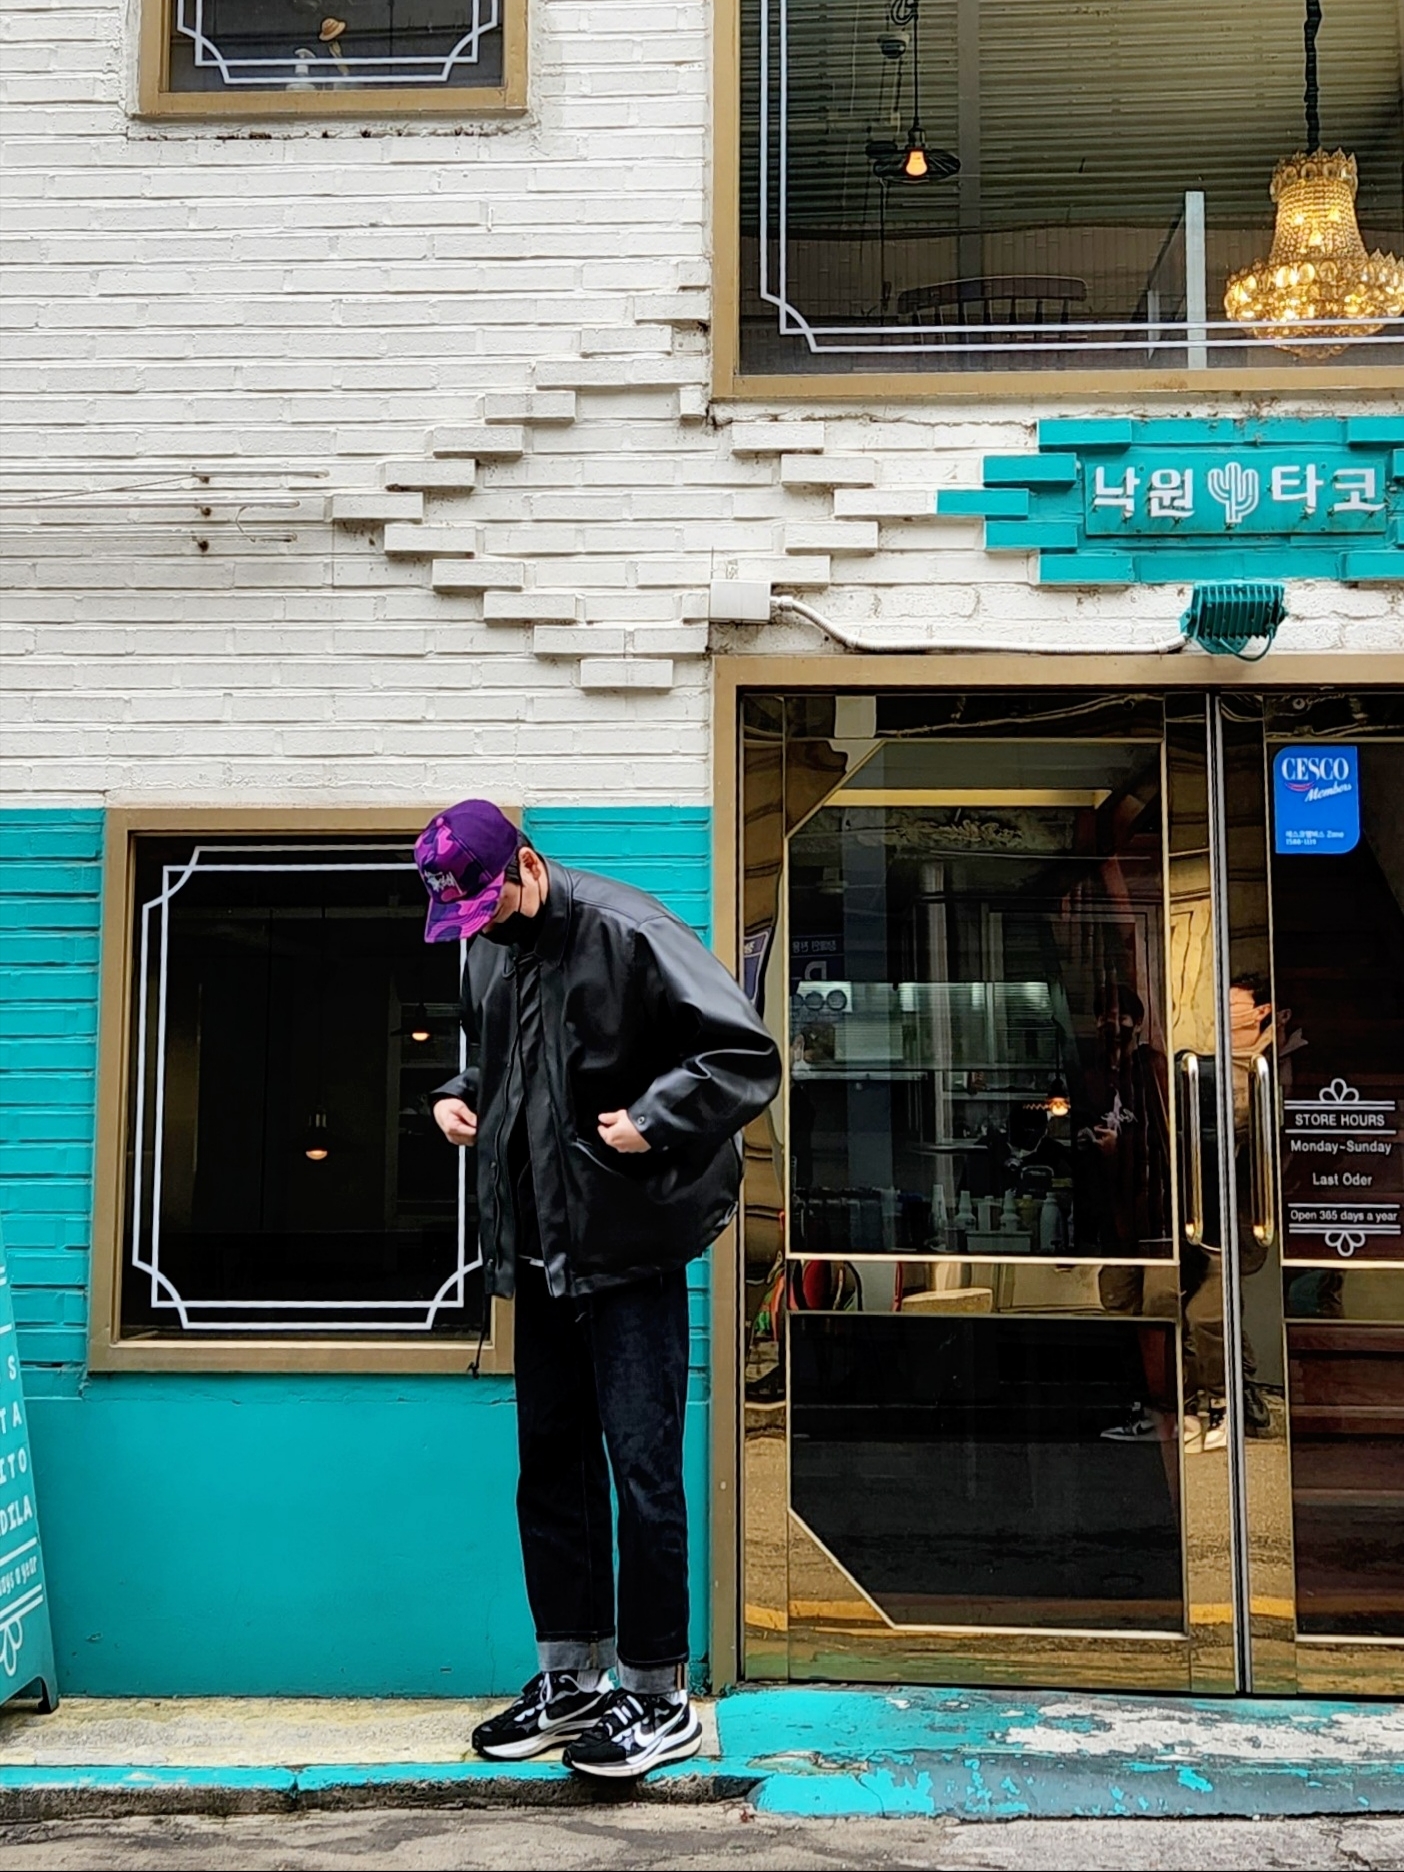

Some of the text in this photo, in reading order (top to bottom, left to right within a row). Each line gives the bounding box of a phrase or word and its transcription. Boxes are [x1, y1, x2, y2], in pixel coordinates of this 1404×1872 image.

[1094, 464, 1386, 518] 낙원 타코
[1282, 757, 1349, 781] CESCO
[1304, 781, 1352, 802] Members
[1295, 1113, 1385, 1126] STORE HOURS
[1312, 1172, 1373, 1186] Last Oder
[1290, 1209, 1398, 1223] Open 365 days a year
